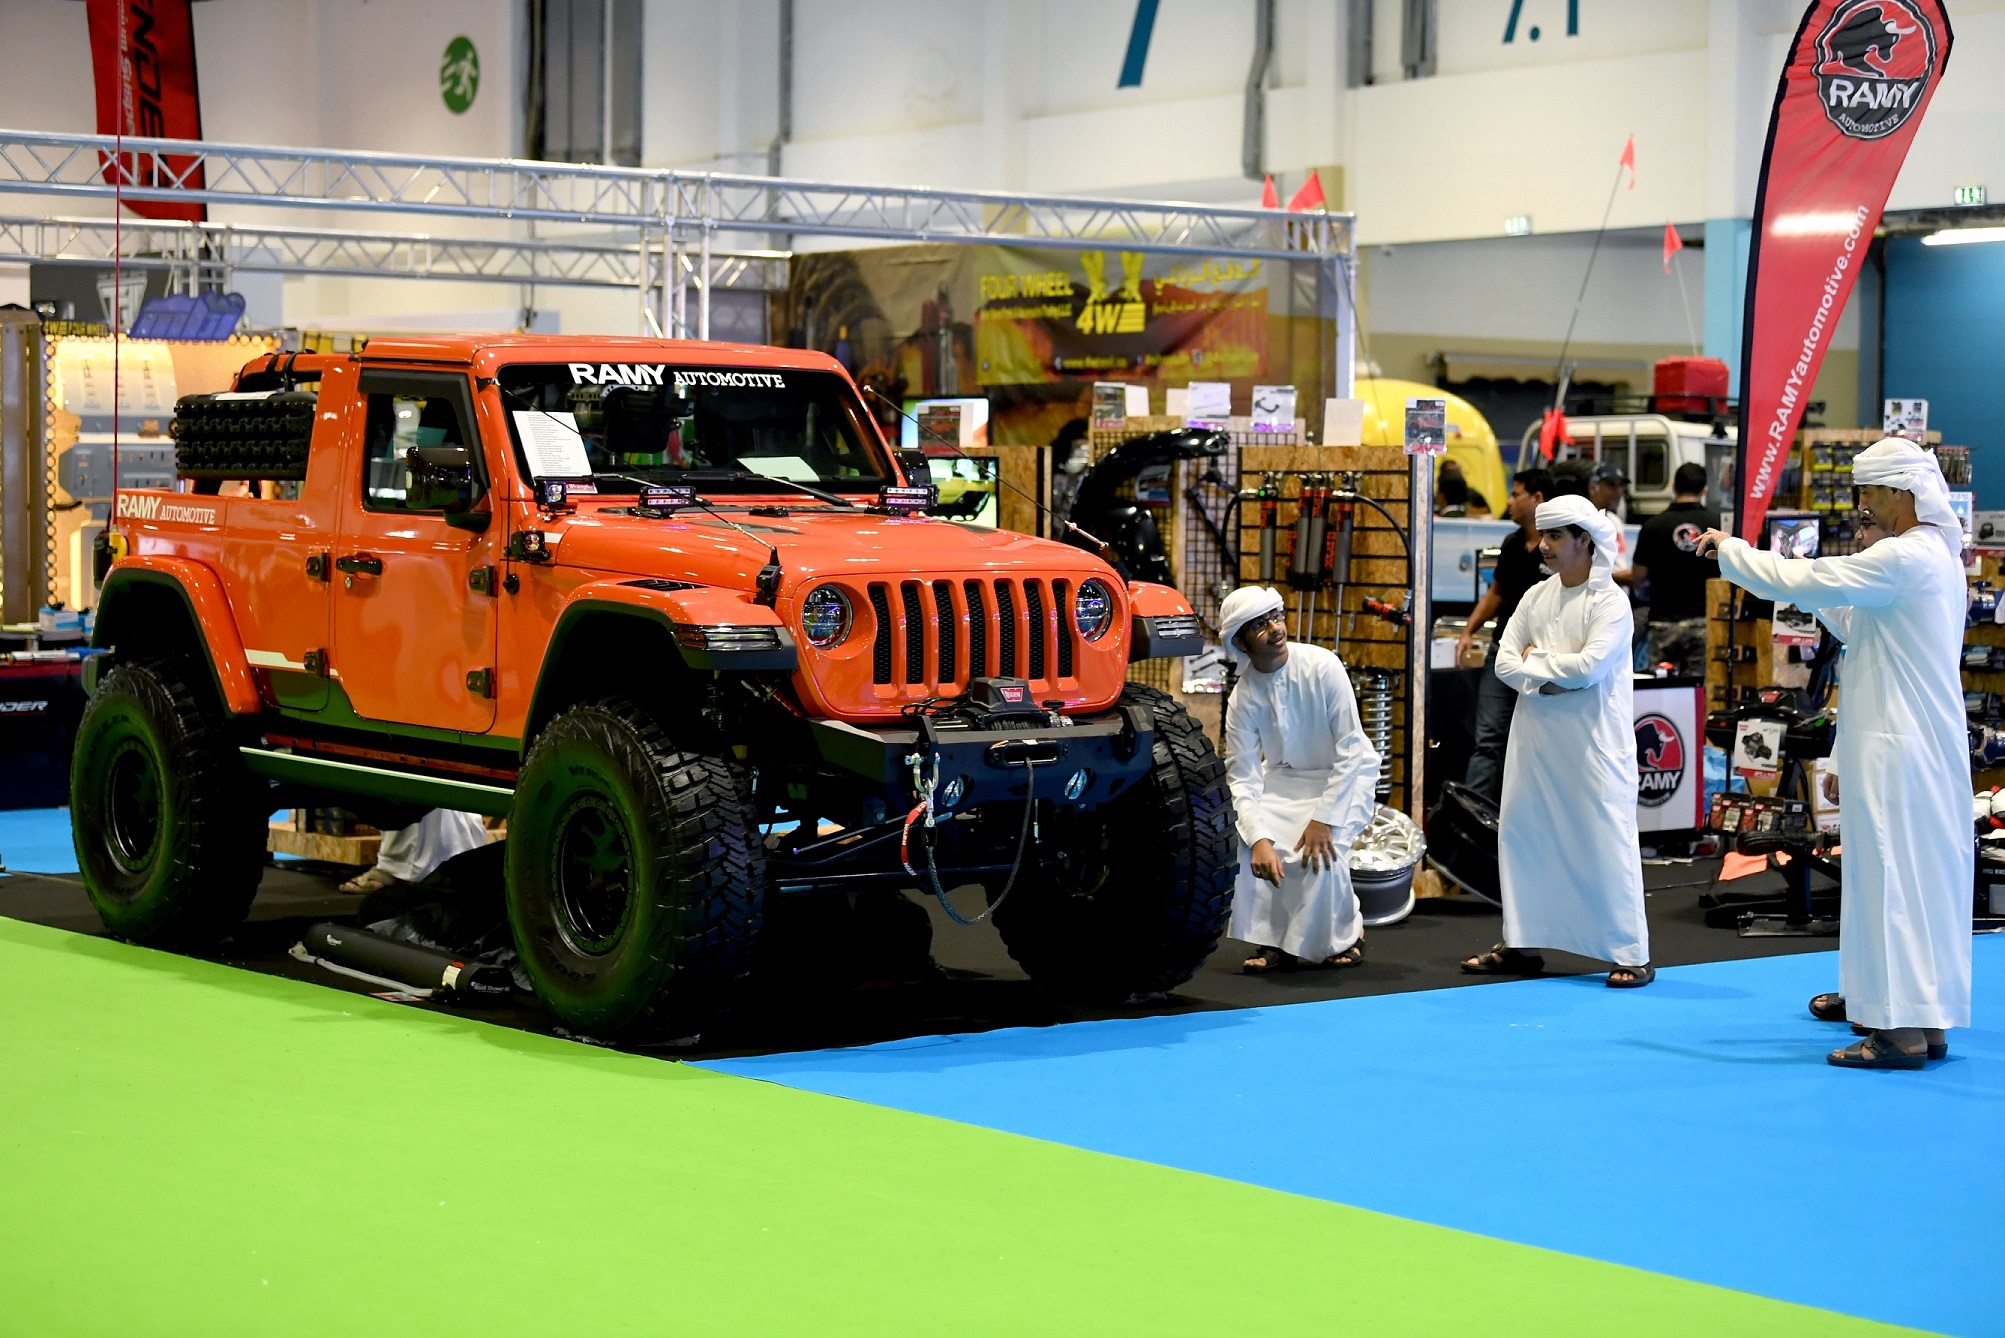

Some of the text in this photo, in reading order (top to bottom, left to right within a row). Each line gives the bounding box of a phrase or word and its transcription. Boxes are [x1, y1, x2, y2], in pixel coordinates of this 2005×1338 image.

[1829, 78, 1919, 109] RAMY
[1838, 113, 1899, 133] AUTOMOTIVE
[980, 271, 1075, 299] FOUR WHEEL
[1749, 204, 1869, 500] www.RAMYautomotive.com
[568, 363, 786, 389] RAMY AUTOMOTIVE
[117, 493, 216, 525] RAMY AUTOMOTIVE
[1638, 770, 1681, 791] AMY
